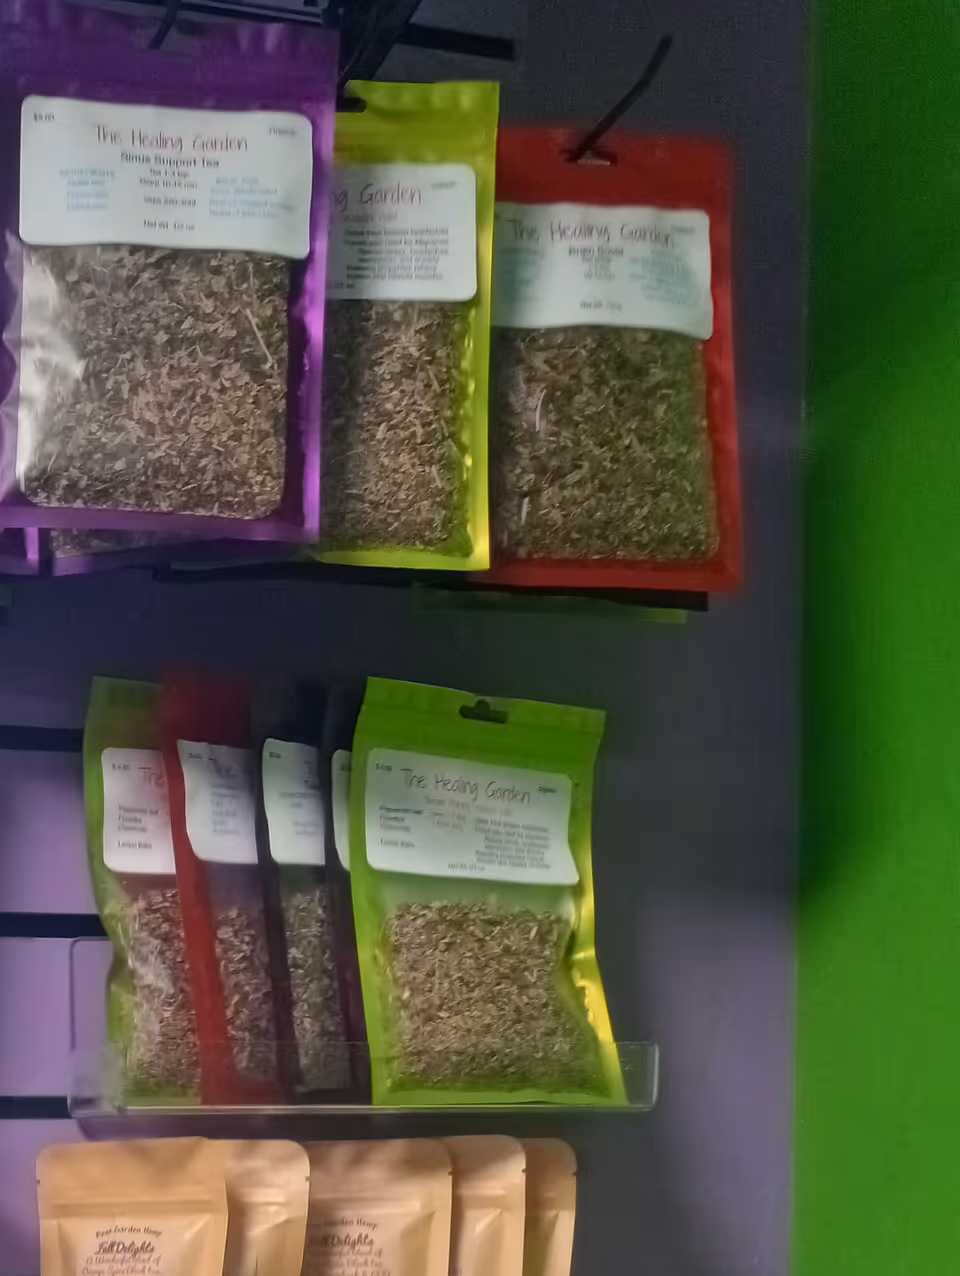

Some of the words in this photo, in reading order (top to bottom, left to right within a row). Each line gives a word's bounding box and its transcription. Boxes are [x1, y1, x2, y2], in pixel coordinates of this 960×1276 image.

[95, 124, 123, 144] The
[131, 128, 184, 154] Healing
[192, 135, 248, 153] Garden
[360, 181, 424, 208] Garden
[550, 220, 611, 243] Healing
[400, 767, 428, 790] The
[434, 773, 479, 801] Healing
[485, 780, 531, 803] Garden
[116, 1240, 155, 1258] Delights
